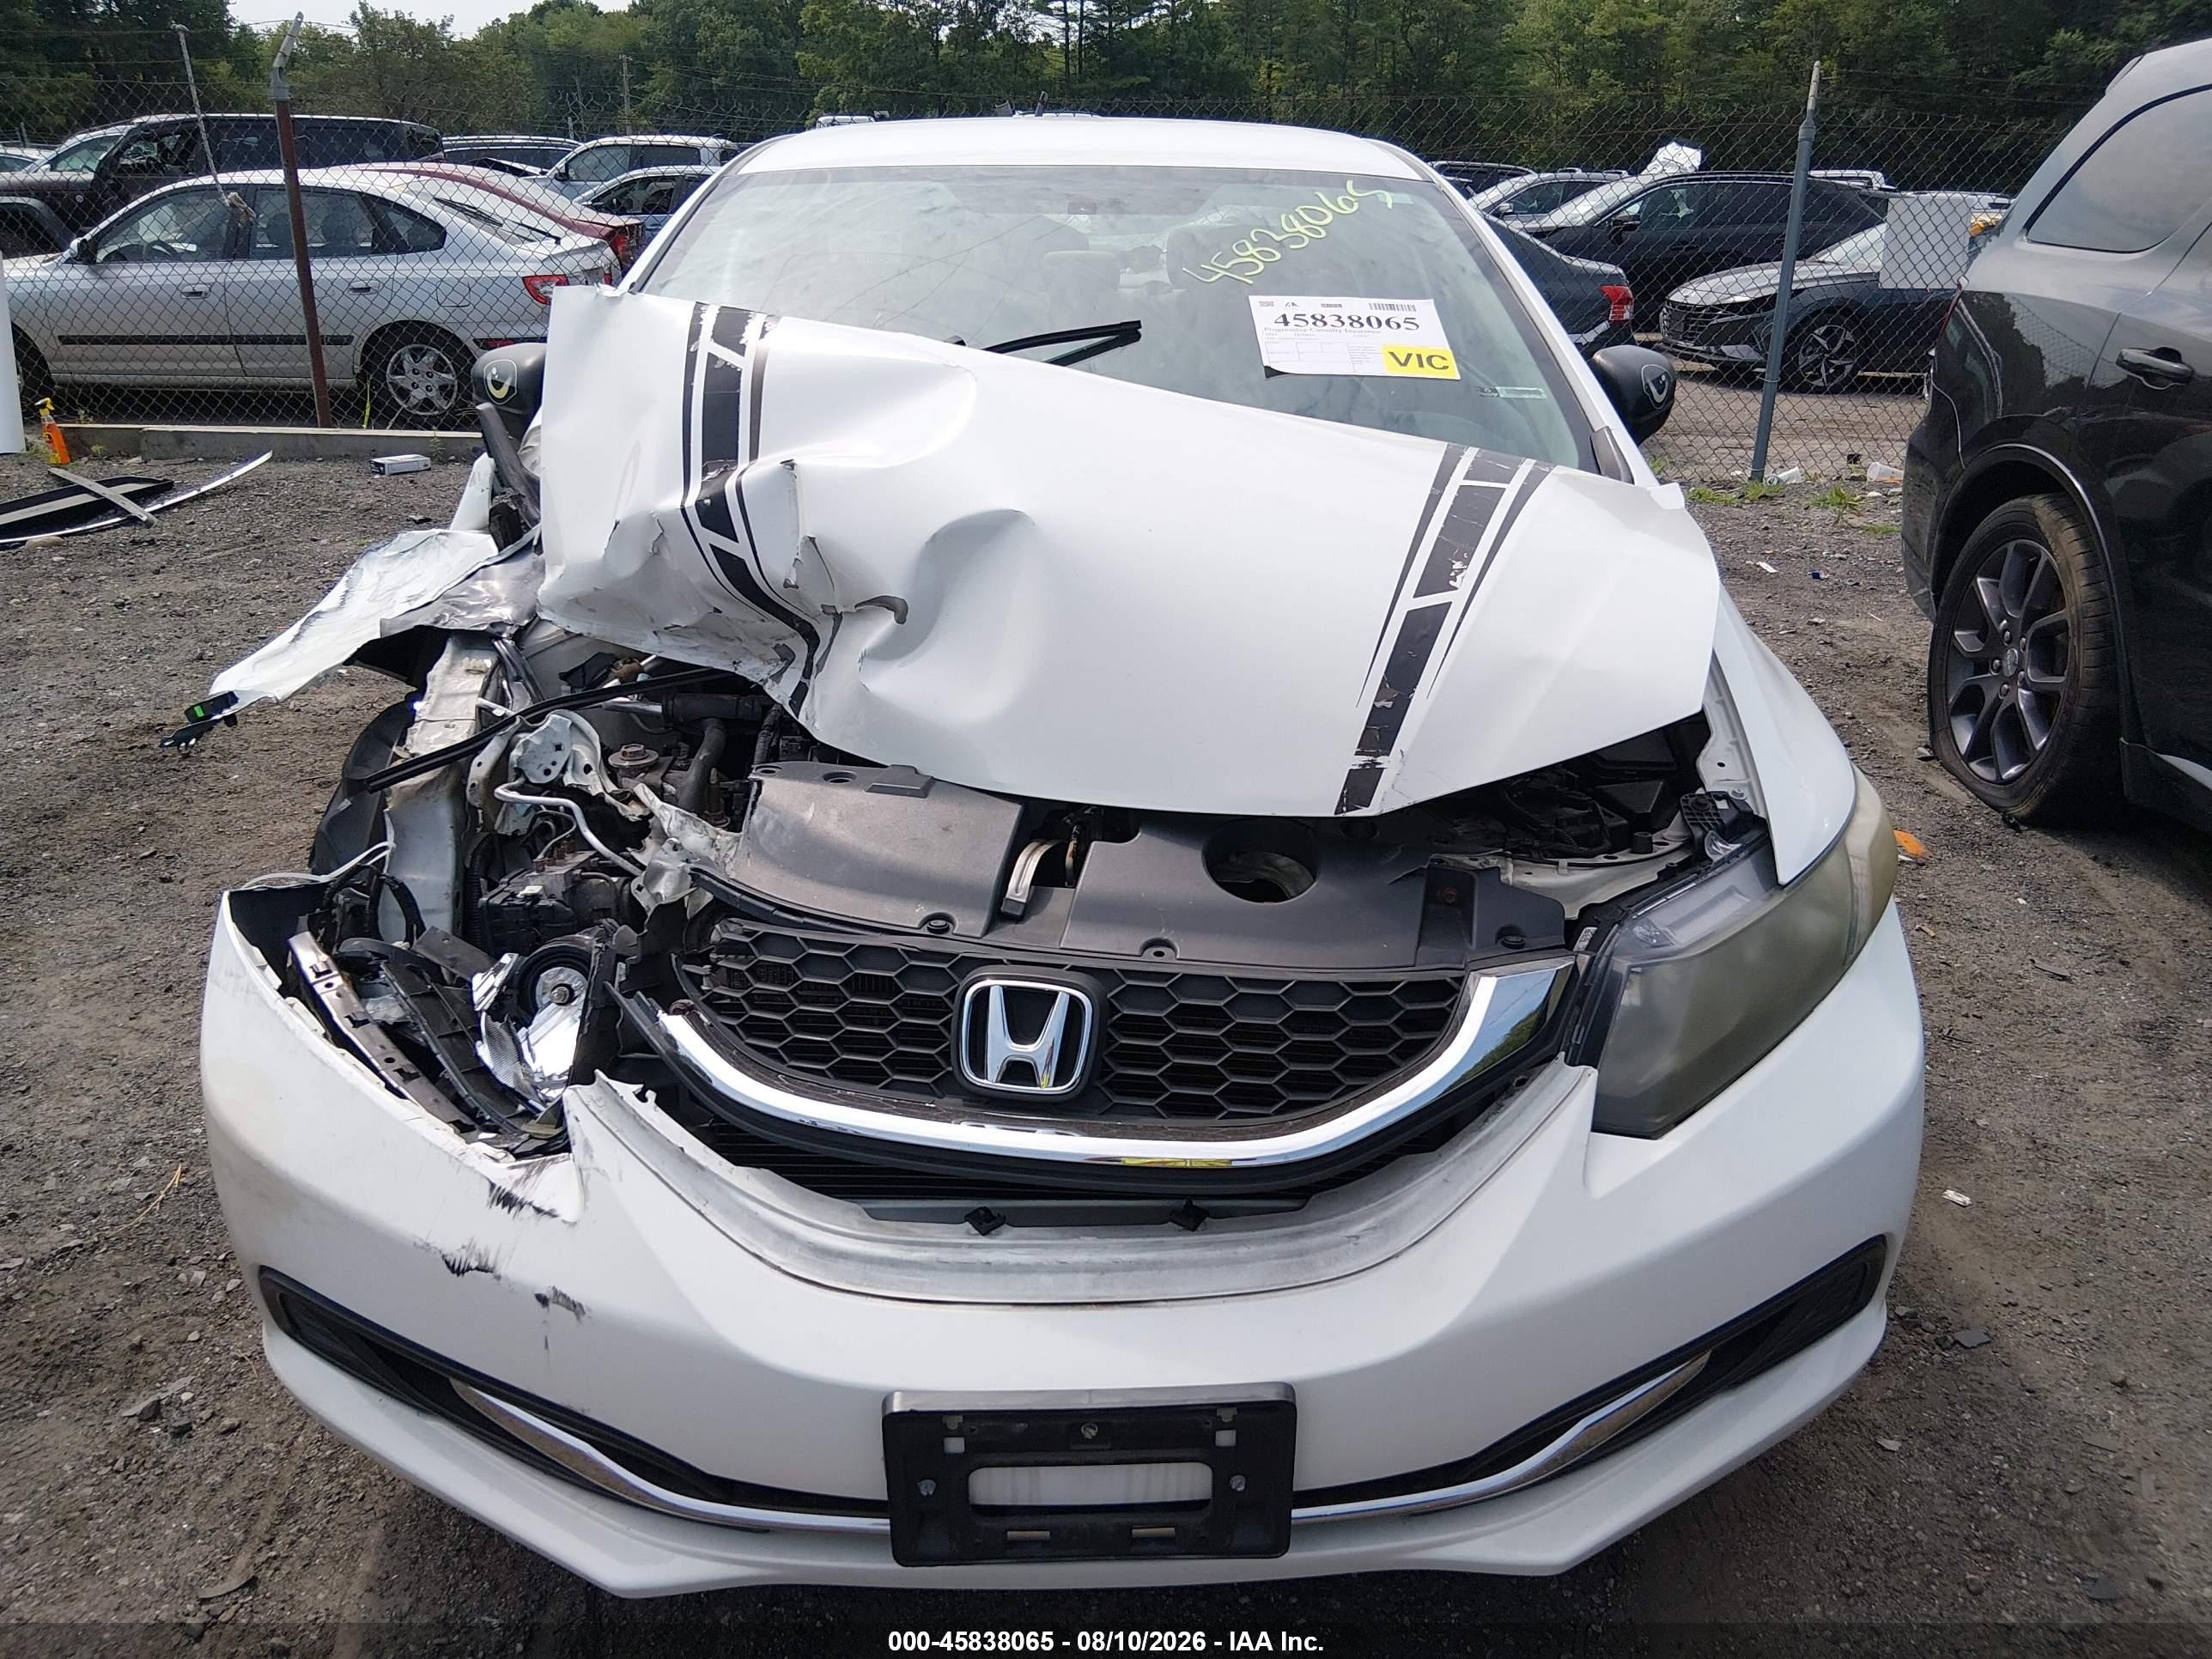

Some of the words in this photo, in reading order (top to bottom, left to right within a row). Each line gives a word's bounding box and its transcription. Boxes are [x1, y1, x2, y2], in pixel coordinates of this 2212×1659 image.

[1182, 179, 1393, 285] 45838065
[1273, 313, 1420, 331] 45838065
[1388, 350, 1450, 371] VIC
